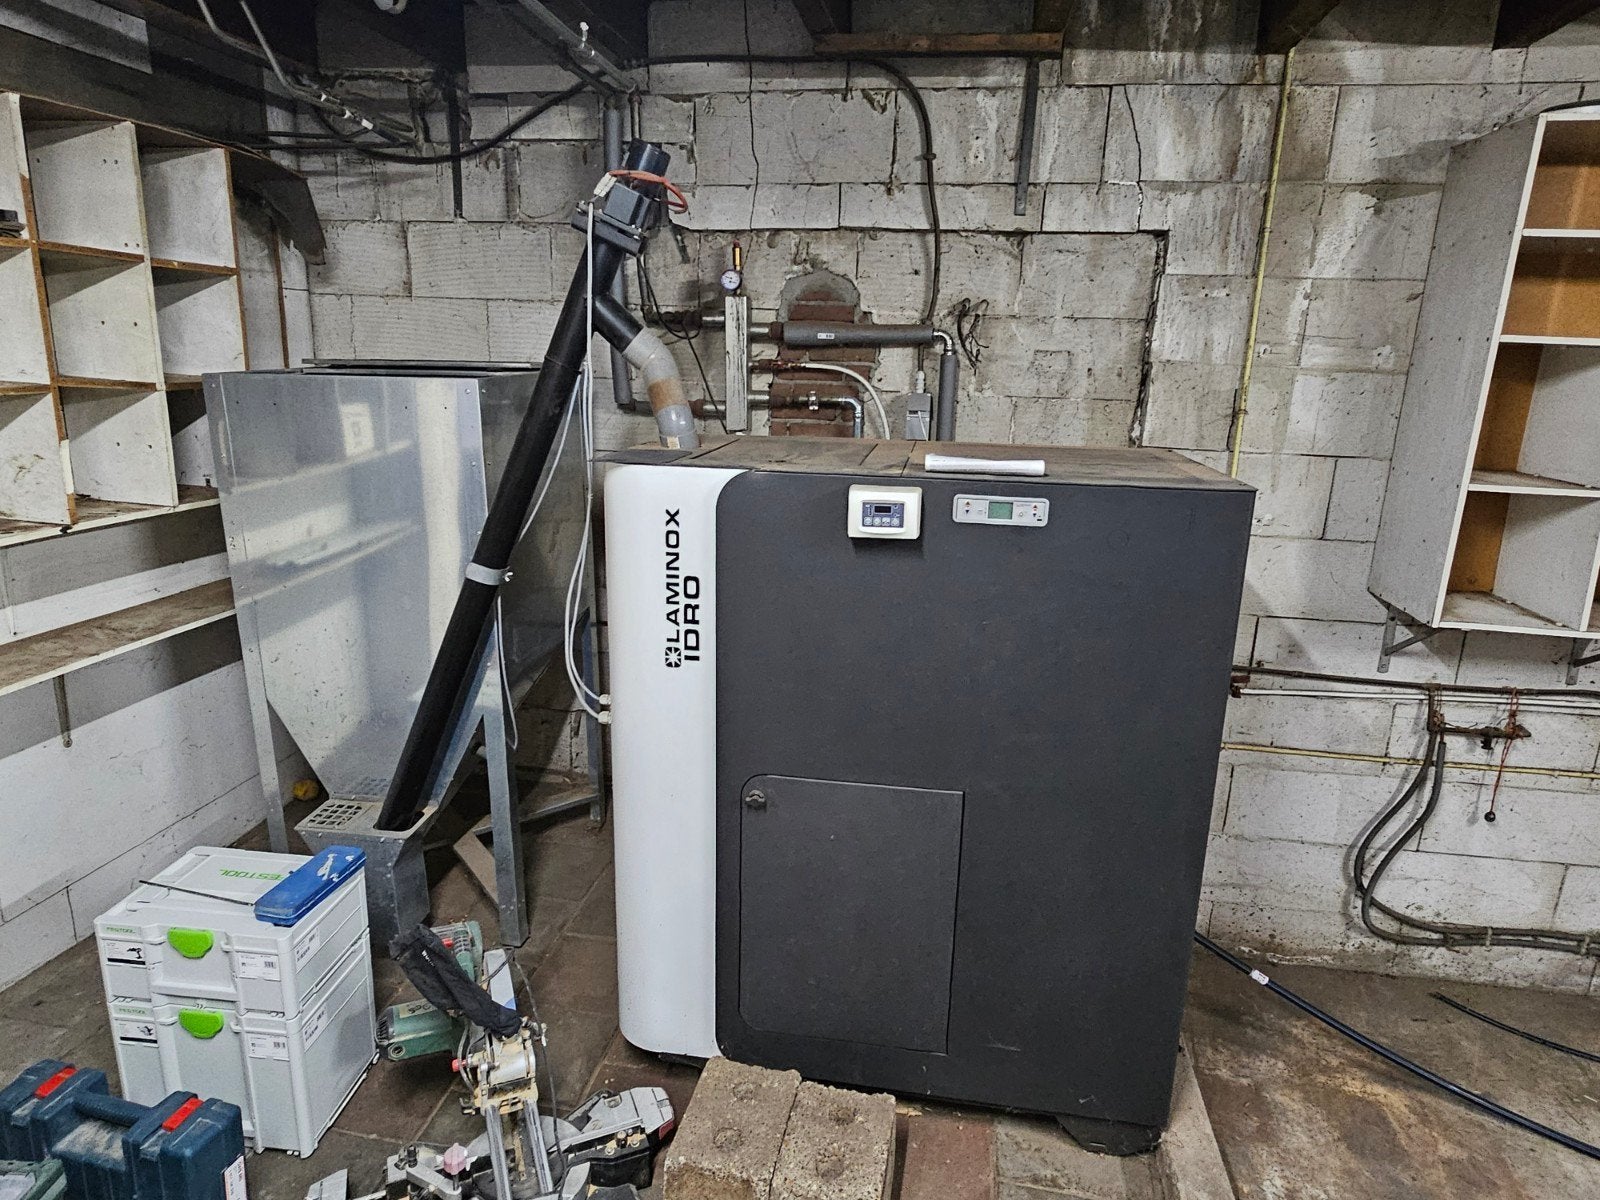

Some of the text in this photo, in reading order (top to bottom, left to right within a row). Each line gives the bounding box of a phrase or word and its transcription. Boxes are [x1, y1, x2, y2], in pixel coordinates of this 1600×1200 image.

[665, 508, 680, 642] LAMINOX
[683, 575, 700, 661] IDRO
[219, 868, 284, 881] ESTOOL
